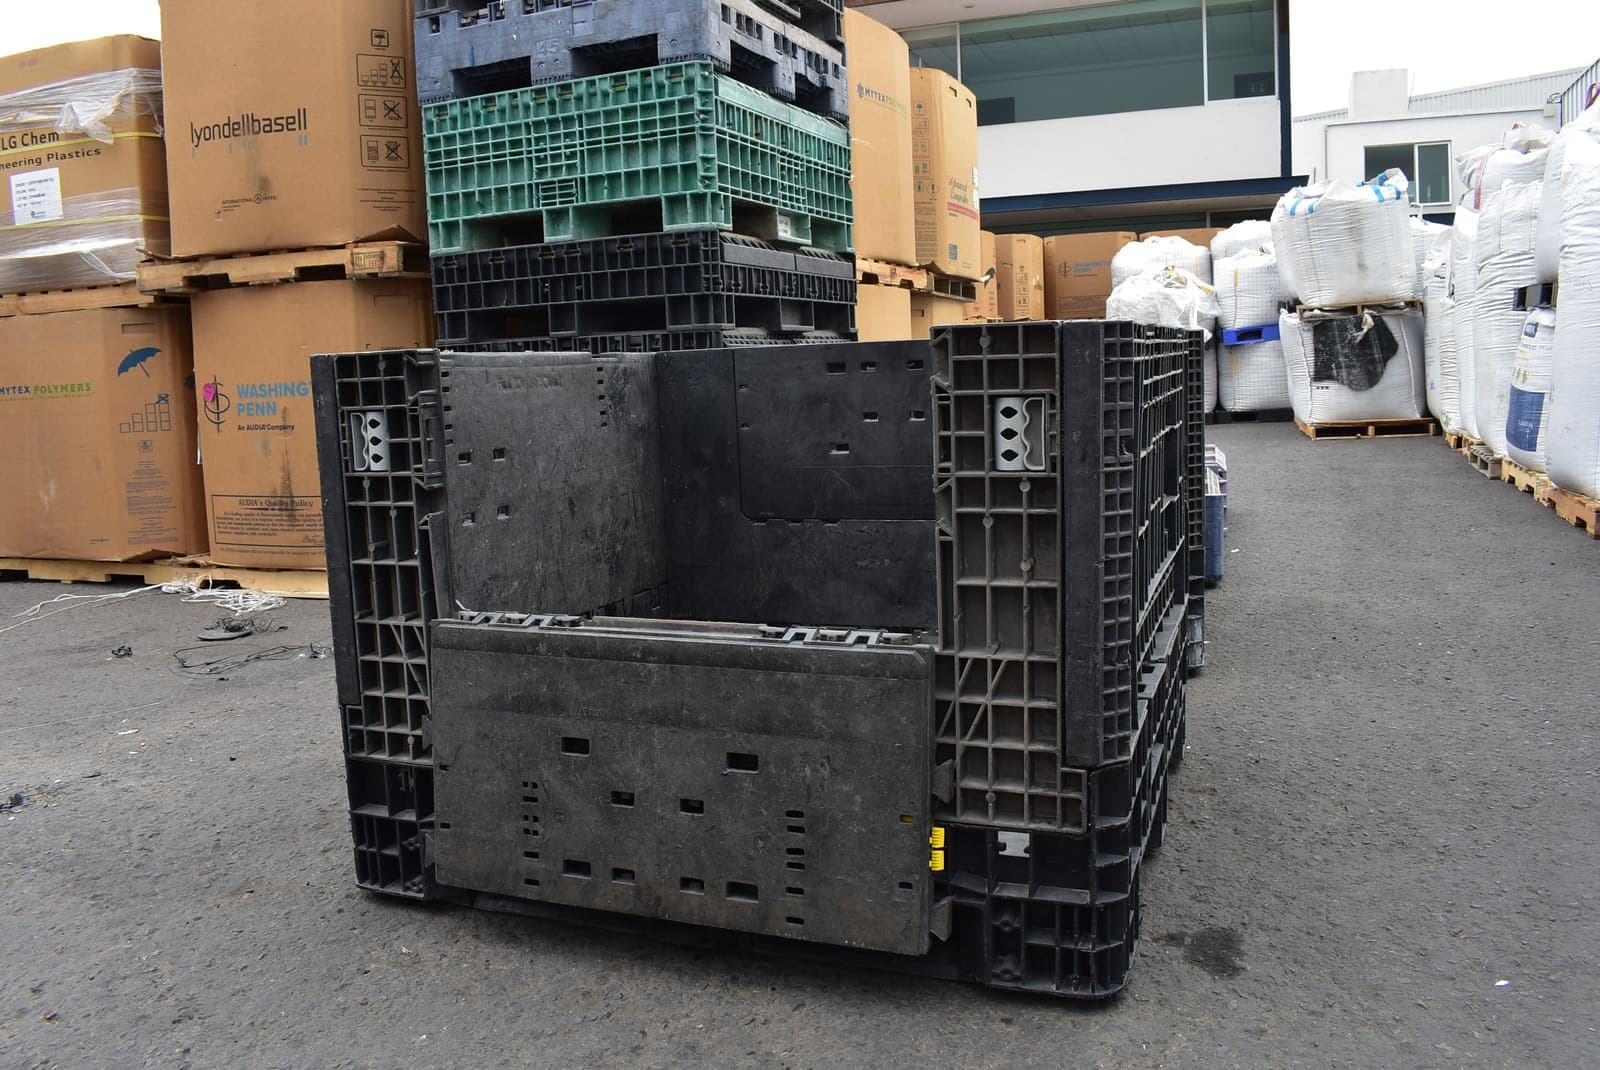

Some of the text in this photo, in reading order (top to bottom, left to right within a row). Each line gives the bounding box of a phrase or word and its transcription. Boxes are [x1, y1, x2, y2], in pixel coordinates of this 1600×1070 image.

[191, 107, 307, 148] lyondellbasell
[2, 131, 60, 150] LG Chem
[47, 148, 101, 162] Plastics
[34, 383, 91, 394] POLYMERS
[237, 380, 313, 399] WASHING
[237, 402, 278, 417] PENN
[267, 424, 295, 432] Company
[290, 499, 314, 508] Policy
